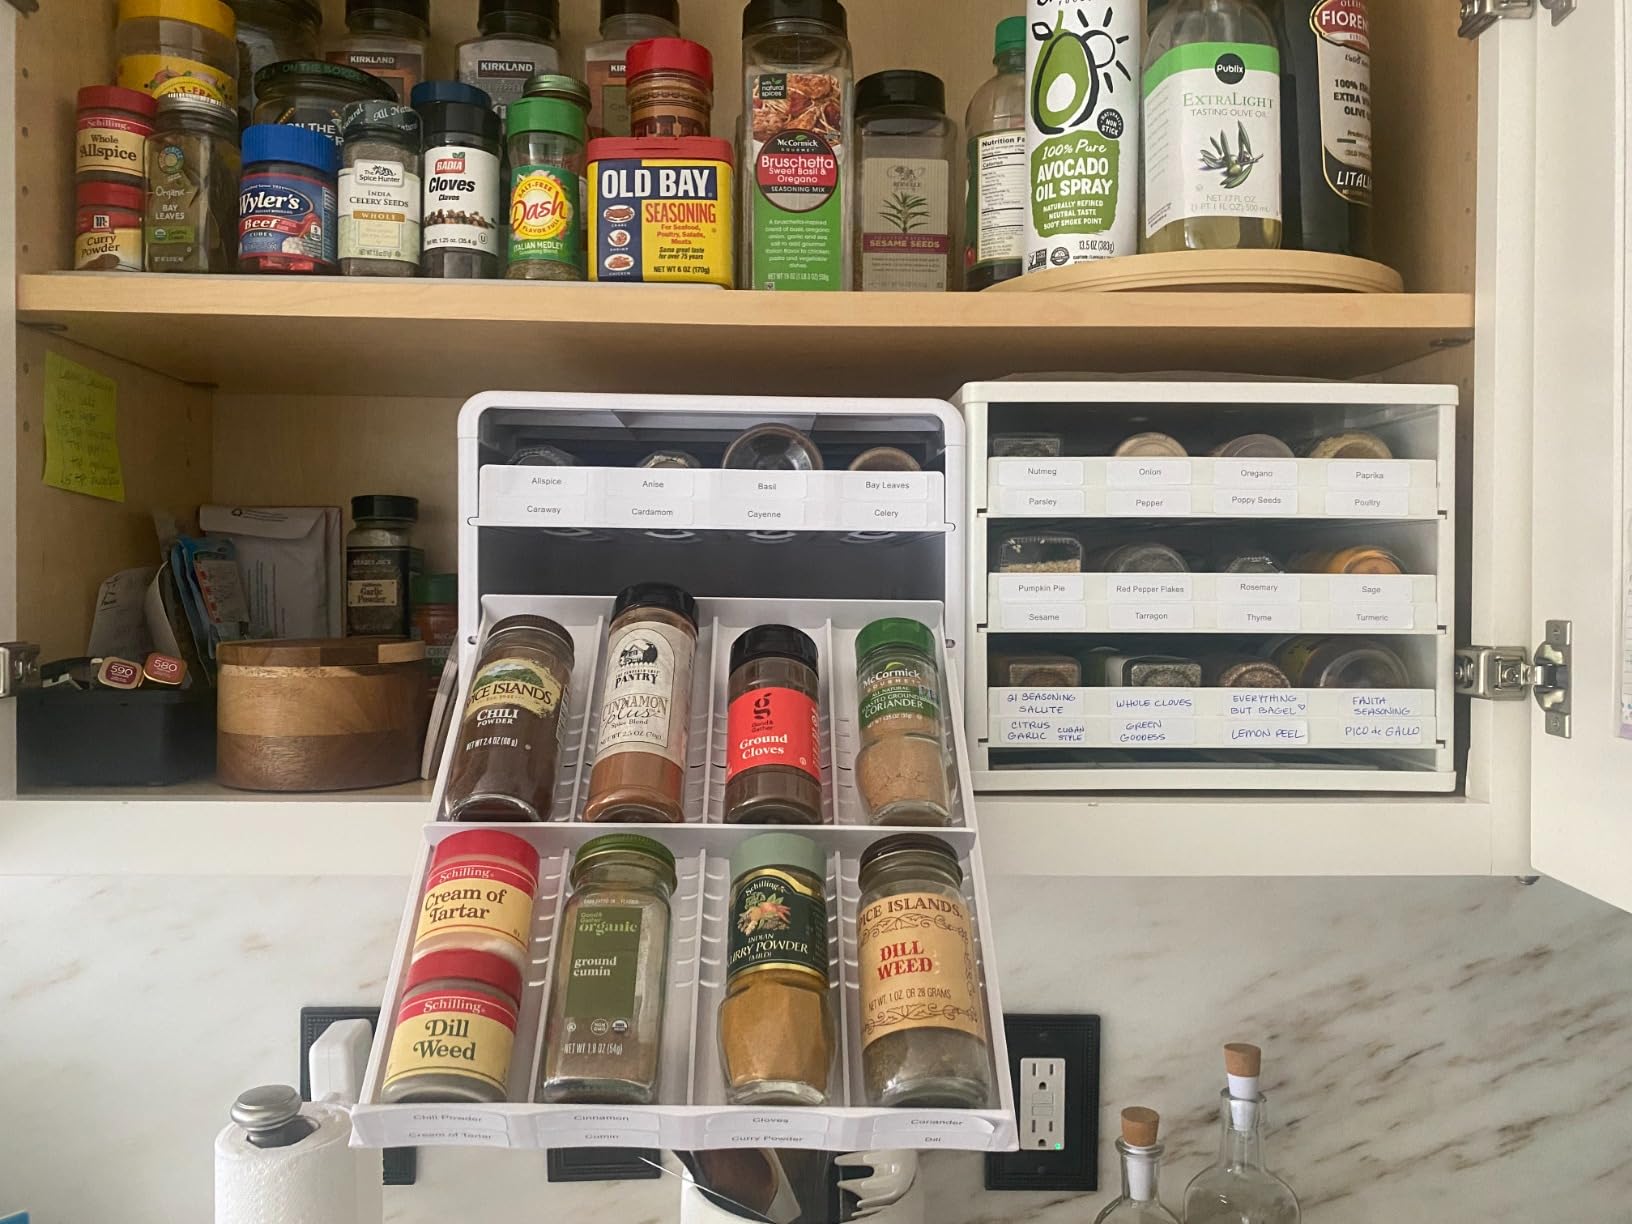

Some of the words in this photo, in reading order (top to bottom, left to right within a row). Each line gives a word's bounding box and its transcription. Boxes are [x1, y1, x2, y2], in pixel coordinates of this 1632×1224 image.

[350, 55, 395, 64] KIRKLAND
[480, 62, 534, 73] KIRKLAND
[1216, 64, 1244, 74] Publix
[1191, 109, 1228, 117] TASTING
[1230, 109, 1253, 118] OLIVE
[87, 119, 127, 130] Schilling
[1105, 118, 1118, 127] NON
[307, 123, 336, 134] THE
[1101, 124, 1119, 136] STICK
[91, 134, 119, 144] Whole
[777, 138, 819, 148] McCormick
[982, 137, 1015, 147] Nutrition
[80, 144, 137, 161] Allspice
[1041, 144, 1074, 160] 100%
[1075, 138, 1107, 153] Pure
[435, 160, 464, 172] BADIA
[761, 155, 834, 169] Bruschetta
[798, 167, 818, 175] Basil
[820, 168, 827, 176] &
[1036, 157, 1109, 183] AVOCADO
[359, 175, 377, 183] Spice
[377, 175, 401, 183] Hunter
[601, 169, 651, 199] OLD
[659, 169, 709, 197] BAY
[777, 175, 818, 185] Oregano
[428, 176, 476, 193] Cloves
[518, 180, 553, 198] SALT-FREE
[367, 190, 392, 198] INDIA
[1036, 184, 1057, 202] OIL
[1060, 178, 1113, 197] SPRAY
[239, 190, 300, 218] Wyler's
[349, 197, 382, 206] CELERY
[384, 199, 409, 208] SEEDS
[1043, 201, 1076, 213] NATURALLY
[1077, 200, 1104, 208] REFINED
[162, 204, 179, 212] BAY
[511, 190, 568, 232] Dash
[645, 202, 717, 224] SEASONING
[155, 212, 185, 221] LEAVES
[1049, 209, 1076, 220] NEUTRAL
[1077, 208, 1097, 217] TASTE
[244, 218, 281, 230] Beef
[87, 235, 117, 247] Curry
[513, 242, 536, 251] ITALIAN
[537, 240, 564, 250] MEDLEY
[869, 239, 908, 248] SESAME
[909, 240, 940, 249] SEEDS
[81, 243, 121, 258] Powder
[1027, 467, 1057, 477] Nutmeg
[1138, 468, 1162, 476] Onion
[1240, 469, 1273, 479] Oregano
[1355, 471, 1384, 481] Paprika
[531, 477, 562, 486] Allspice
[642, 480, 665, 488] Anise
[757, 482, 777, 491] Basil
[865, 481, 881, 491] Bay
[882, 481, 910, 490] Leaves
[1028, 497, 1057, 507] Parsley
[1135, 499, 1164, 509] Pepper
[1231, 496, 1256, 505] Poppy
[1257, 495, 1282, 505] Seeds
[1354, 498, 1381, 508] Poultry
[526, 505, 561, 515] Caraway
[631, 508, 674, 517] Cardamom
[747, 510, 782, 520] Cayenne
[874, 508, 899, 519] Celery
[1018, 584, 1051, 594] Pumpkin
[1052, 584, 1066, 593] Pie
[1116, 585, 1131, 593] Red
[1132, 585, 1159, 595] Pepper
[1160, 585, 1185, 594] Flakes
[1240, 583, 1278, 593] Rosemary
[1361, 586, 1382, 595] Sage
[1028, 613, 1060, 622] Sesame
[1135, 612, 1168, 622] Tarragon
[1247, 613, 1273, 623] Thyme
[1356, 613, 1389, 622] Turmeric
[110, 664, 134, 677] 590
[153, 659, 178, 672] 580
[615, 673, 658, 689] PANTRY
[863, 668, 921, 689] McCormick
[493, 682, 552, 705] ISLANDS
[1021, 693, 1076, 702] SEASONING
[1116, 699, 1151, 709] WHOLE
[1154, 698, 1193, 708] CLOVES
[1232, 694, 1297, 704] EVERYTHING
[601, 695, 669, 721] CINNAMON
[864, 698, 924, 719] CORIANDER
[1018, 705, 1064, 715] SALUTE
[1230, 706, 1253, 715] BUT
[1258, 706, 1297, 715] BAGEL
[1354, 708, 1411, 716] SEASONING
[476, 708, 520, 721] CHILI
[1011, 721, 1051, 730] CITRUS
[1057, 726, 1085, 734] CUBAN
[1125, 719, 1163, 731] GREEN
[1007, 731, 1048, 741] GARLIC
[1231, 728, 1271, 740] LEMON
[1275, 728, 1305, 739] PEEL
[1345, 726, 1369, 736] PICO
[1371, 726, 1382, 735] de
[1385, 726, 1421, 737] GALLO
[739, 733, 788, 750] Ground
[1058, 734, 1083, 742] STYLE
[1119, 733, 1166, 743] GODDESS
[742, 746, 785, 760] Cloves
[439, 866, 491, 884] Schilling
[745, 880, 780, 897] Schilling
[425, 889, 482, 912] Cream
[486, 889, 509, 905] of
[887, 897, 961, 917] ISLANDS
[429, 904, 491, 925] Tartar
[578, 920, 639, 936] organic
[748, 933, 774, 943] INDIAN
[728, 944, 754, 966] URRY
[756, 939, 808, 955] POWDER
[880, 940, 925, 963] DILL
[574, 956, 618, 969] ground
[573, 966, 611, 977] cumin
[877, 957, 934, 981] WEED
[423, 999, 483, 1015] Schilling
[425, 1018, 470, 1038] Dill
[413, 1039, 477, 1061] Weed
[413, 1114, 439, 1122] Chili
[441, 1115, 483, 1123] Powder
[573, 1114, 630, 1122] Cinnamon
[752, 1116, 790, 1124] Cloves
[911, 1119, 964, 1127] Coriander
[408, 1131, 446, 1139] Cream
[448, 1131, 459, 1139] of
[461, 1131, 492, 1140] Tartar
[584, 1133, 620, 1141] Cumin
[731, 1135, 760, 1144] Curry
[763, 1134, 805, 1143] Powder
